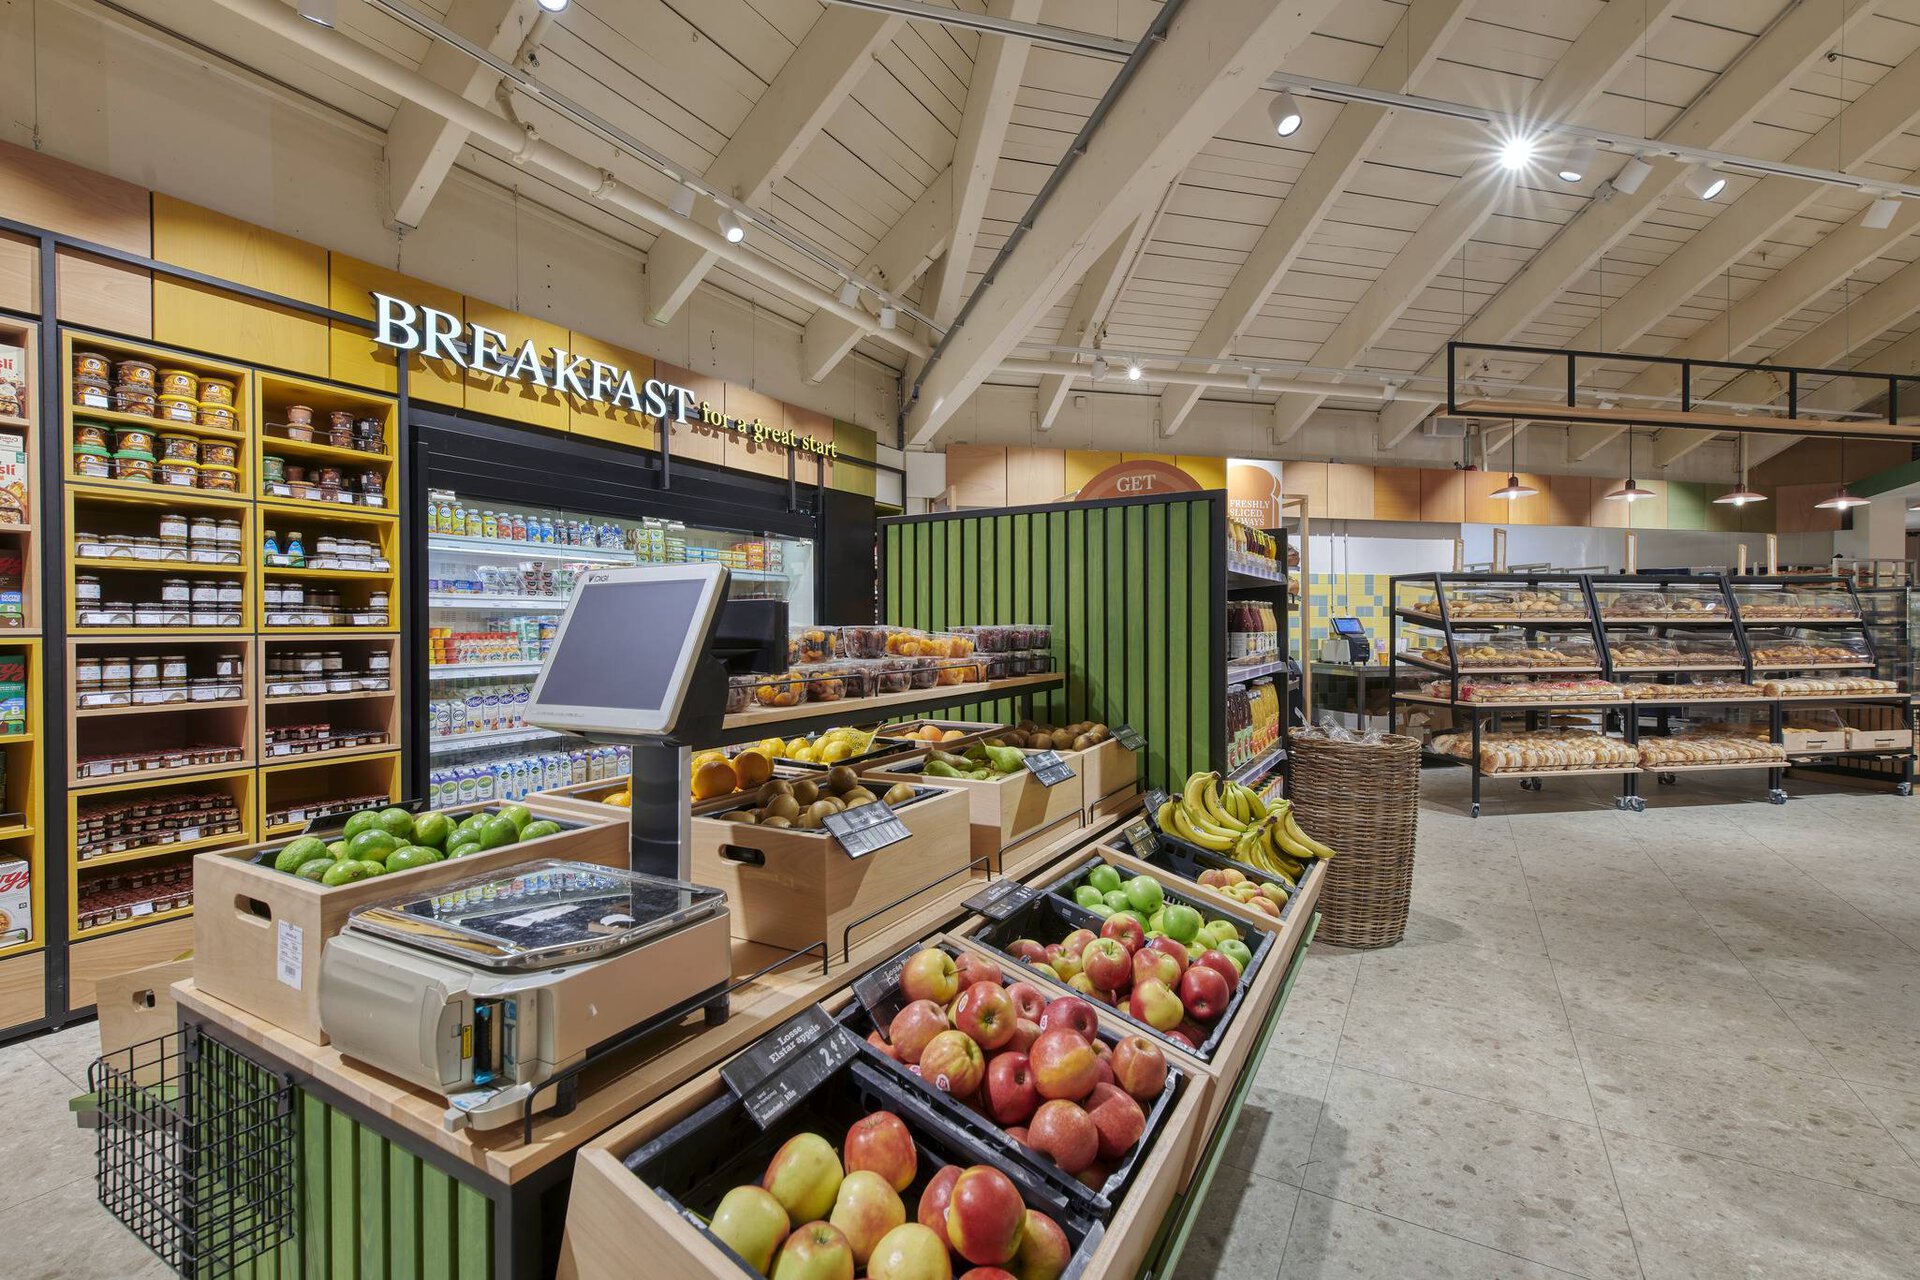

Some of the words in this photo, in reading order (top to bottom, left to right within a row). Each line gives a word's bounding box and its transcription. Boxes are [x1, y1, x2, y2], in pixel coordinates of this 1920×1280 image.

[370, 290, 695, 425] BREAKFAST
[702, 401, 731, 428] for
[737, 419, 747, 433] a
[753, 417, 797, 447] great
[802, 433, 838, 458] start
[1116, 474, 1156, 492] GET
[1230, 499, 1270, 509] FRESHLY
[594, 574, 609, 583] DIGI
[769, 1042, 796, 1065] Elstar
[795, 1023, 821, 1046] appels
[777, 1024, 803, 1047] Losse
[779, 1081, 788, 1091] 1
